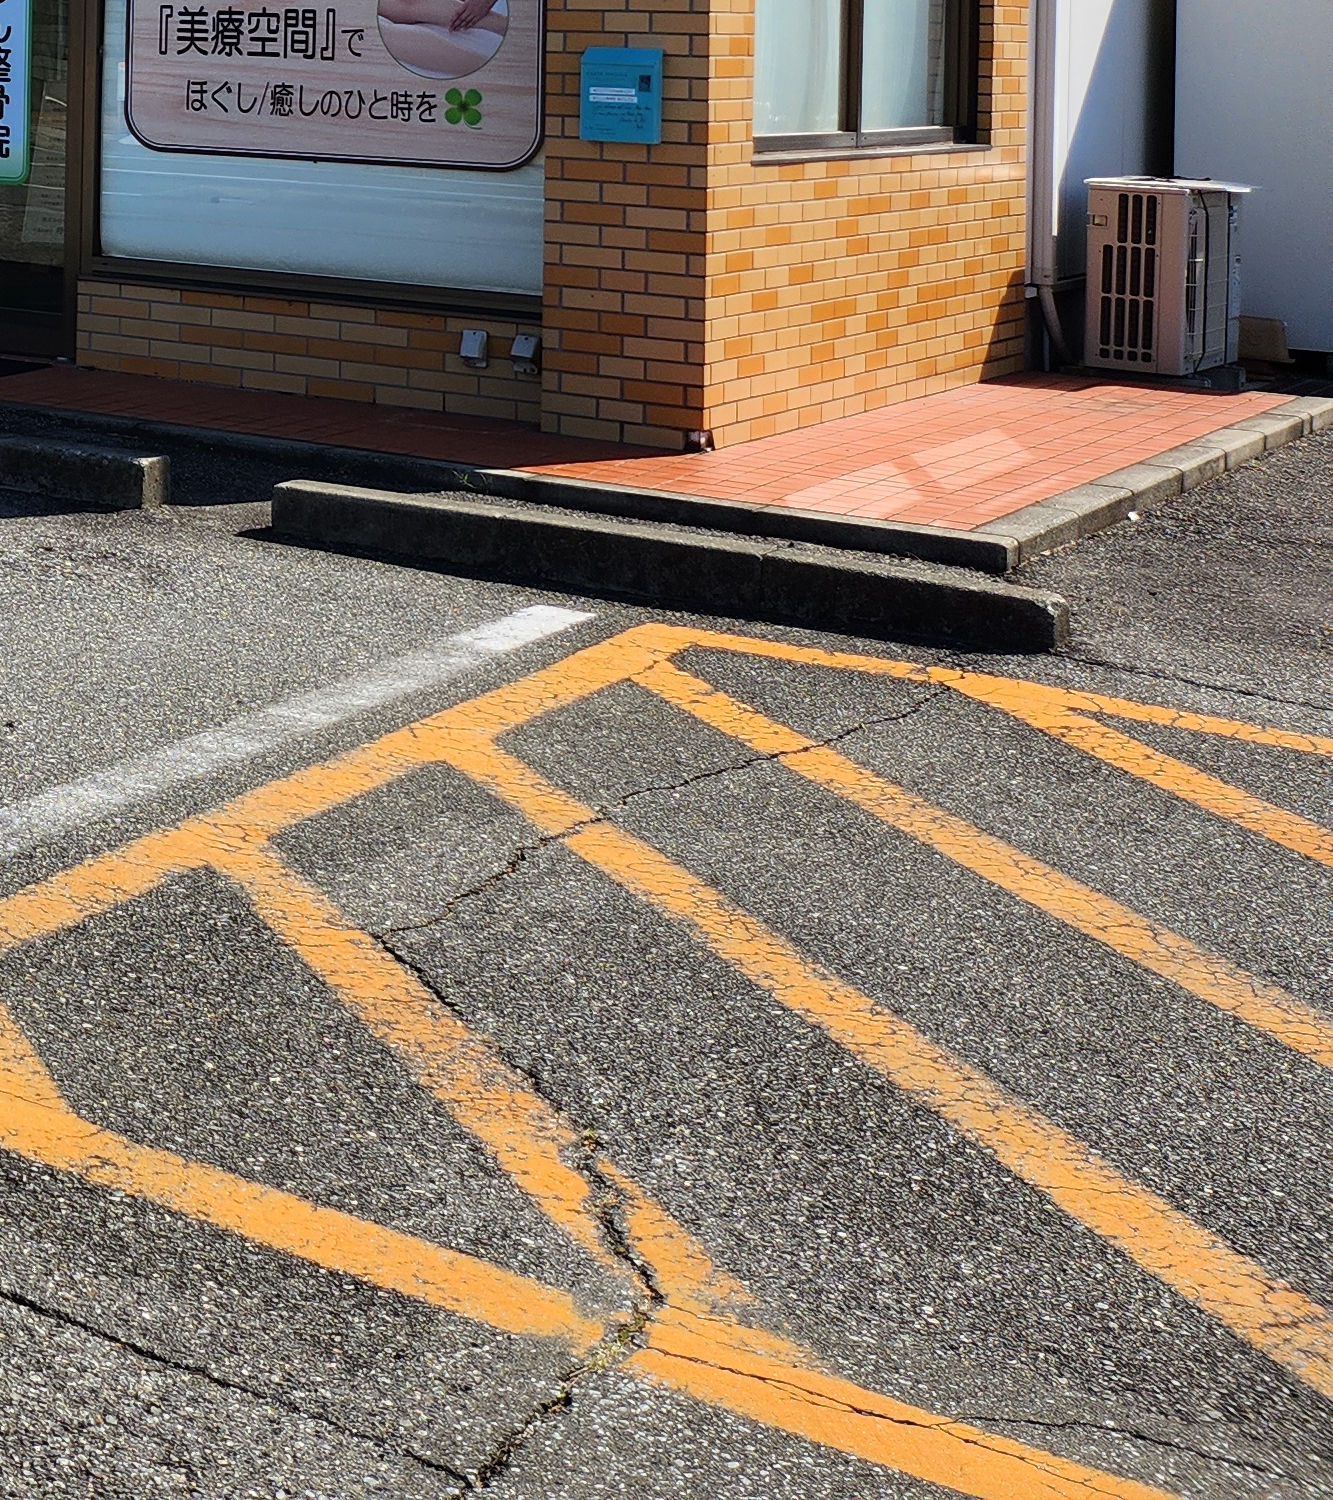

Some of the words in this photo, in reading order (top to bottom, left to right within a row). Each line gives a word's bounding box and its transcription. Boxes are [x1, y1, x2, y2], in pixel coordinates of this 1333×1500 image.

[158, 5, 365, 62] 『美療空間』で
